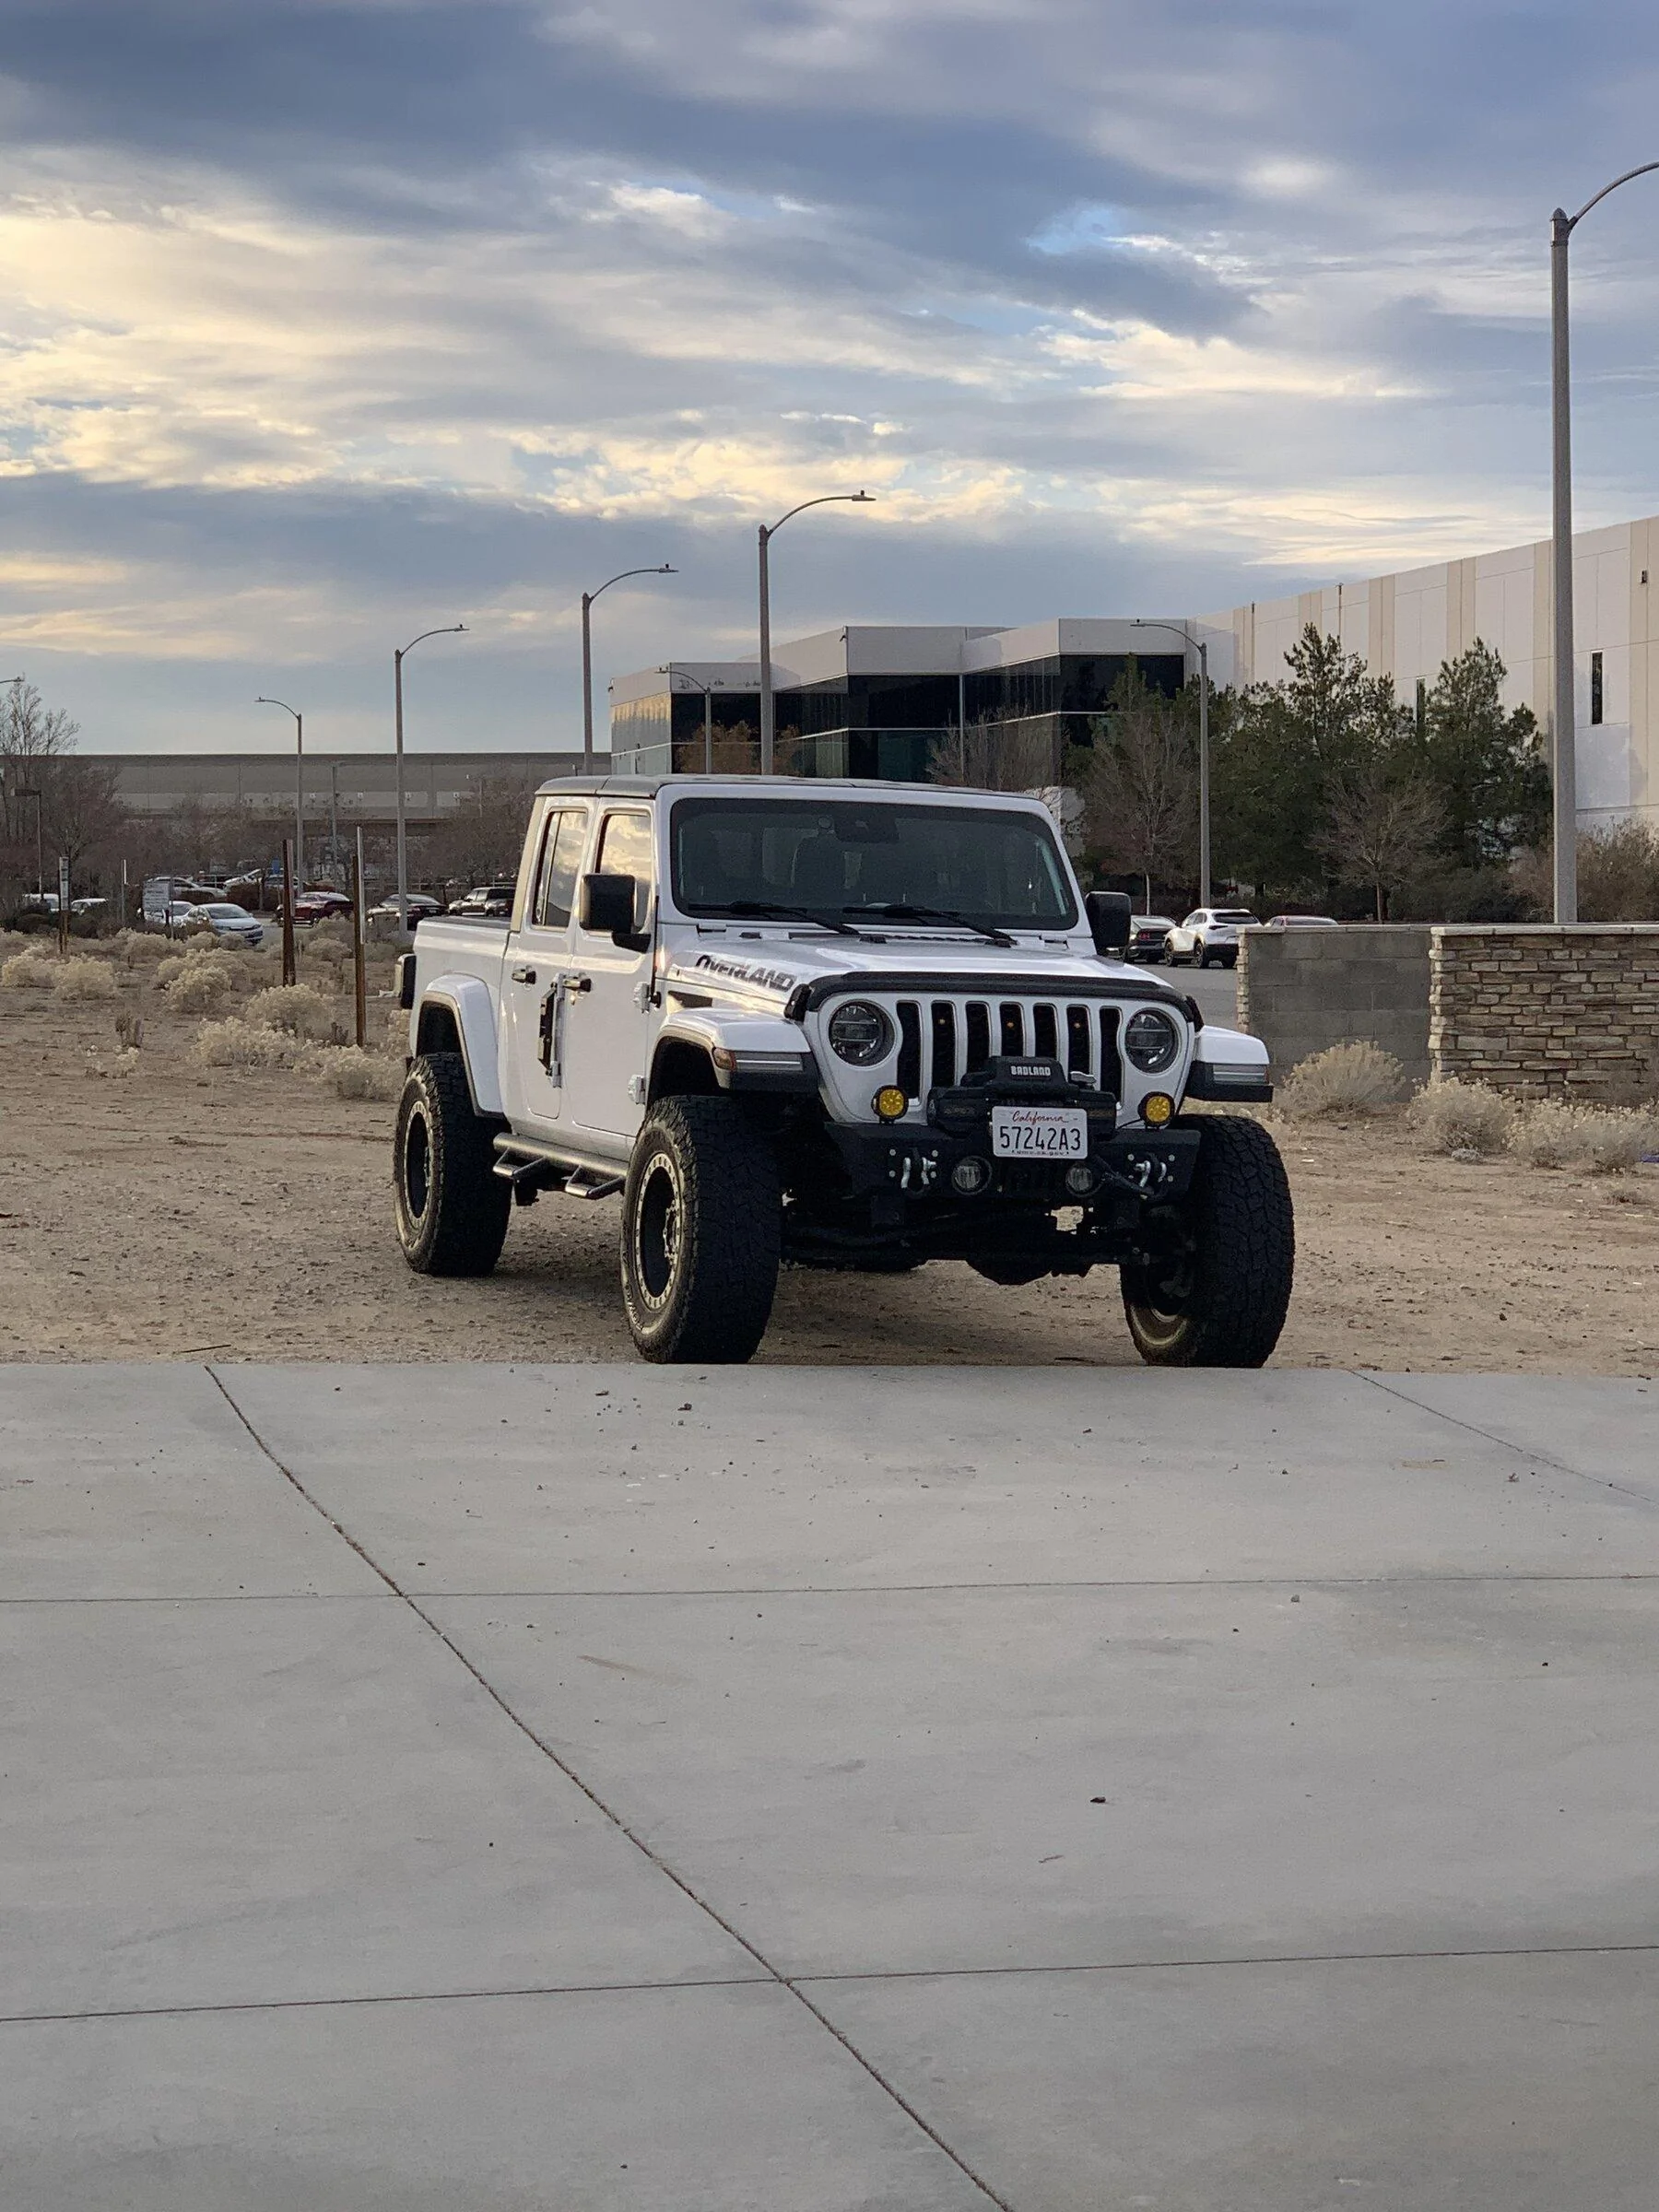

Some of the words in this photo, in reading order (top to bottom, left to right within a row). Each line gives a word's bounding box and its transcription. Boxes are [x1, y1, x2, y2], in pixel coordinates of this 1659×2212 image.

[695, 955, 797, 993] OVERLAND
[1010, 1065, 1051, 1077] BADLAND
[1012, 1110, 1069, 1125] California
[999, 1125, 1081, 1151] 57242A3
